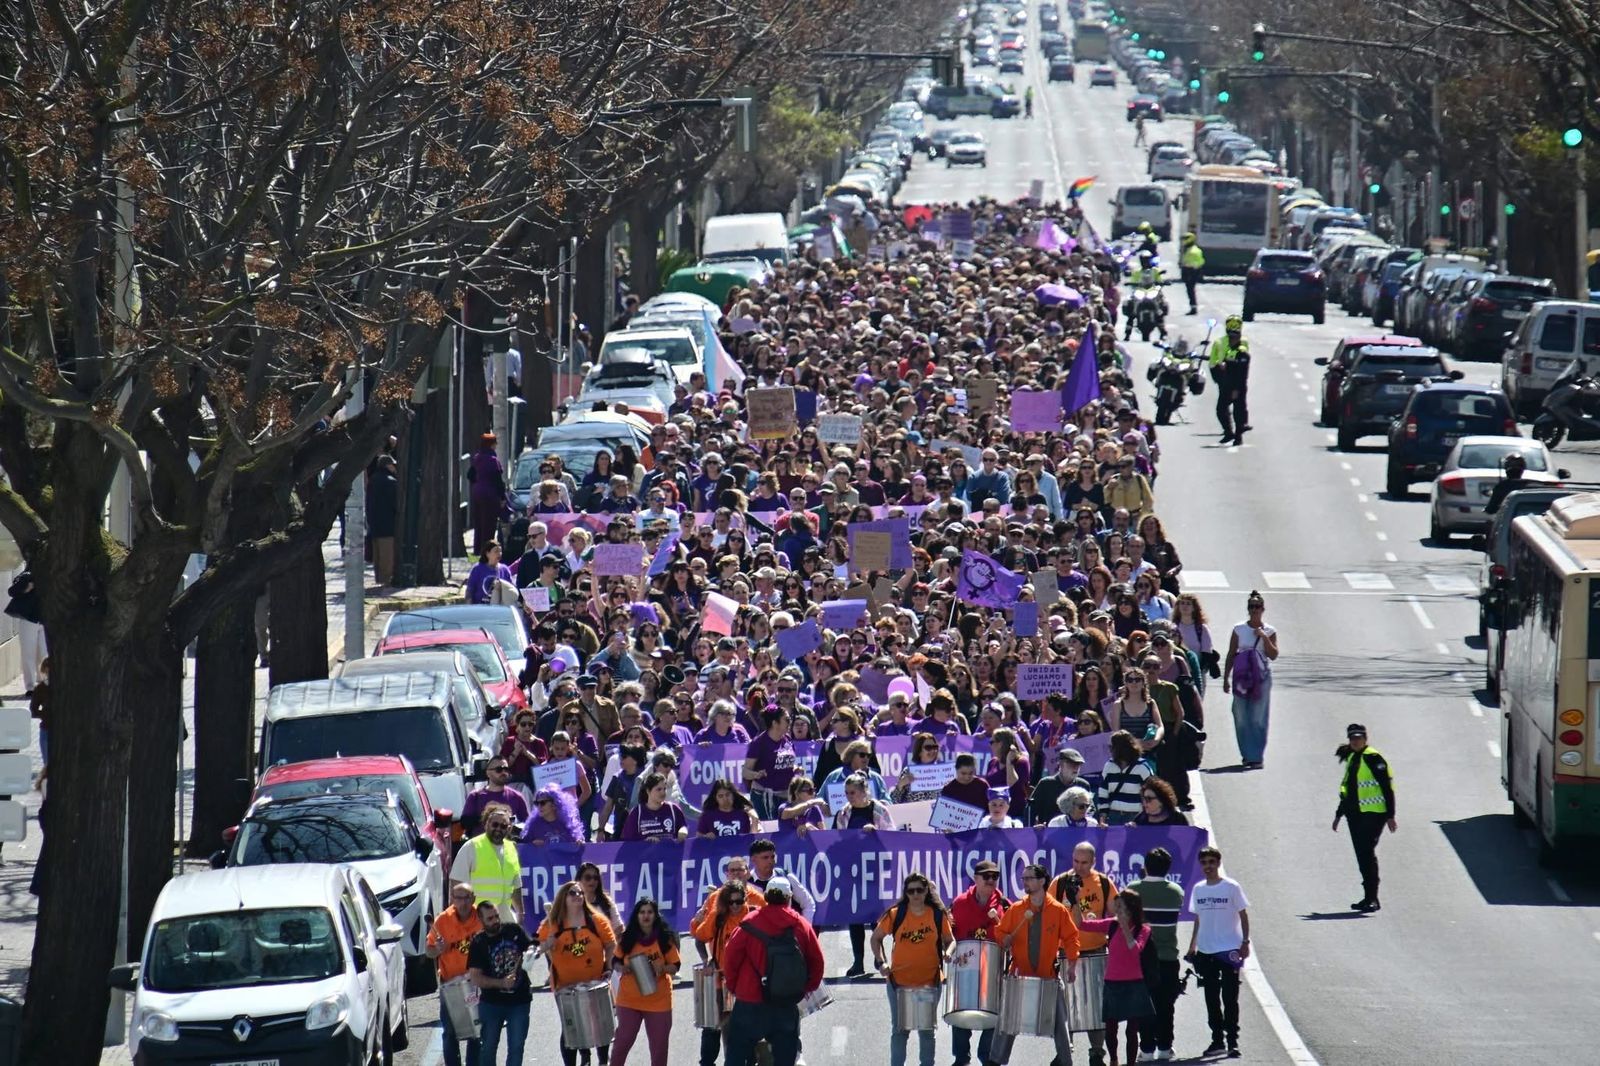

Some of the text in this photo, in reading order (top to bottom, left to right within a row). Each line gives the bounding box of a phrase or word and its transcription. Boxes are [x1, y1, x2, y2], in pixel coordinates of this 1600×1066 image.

[690, 760, 746, 785] CONT
[520, 863, 625, 915] FREE
[635, 861, 673, 910] AL
[681, 851, 841, 909] FASMO:
